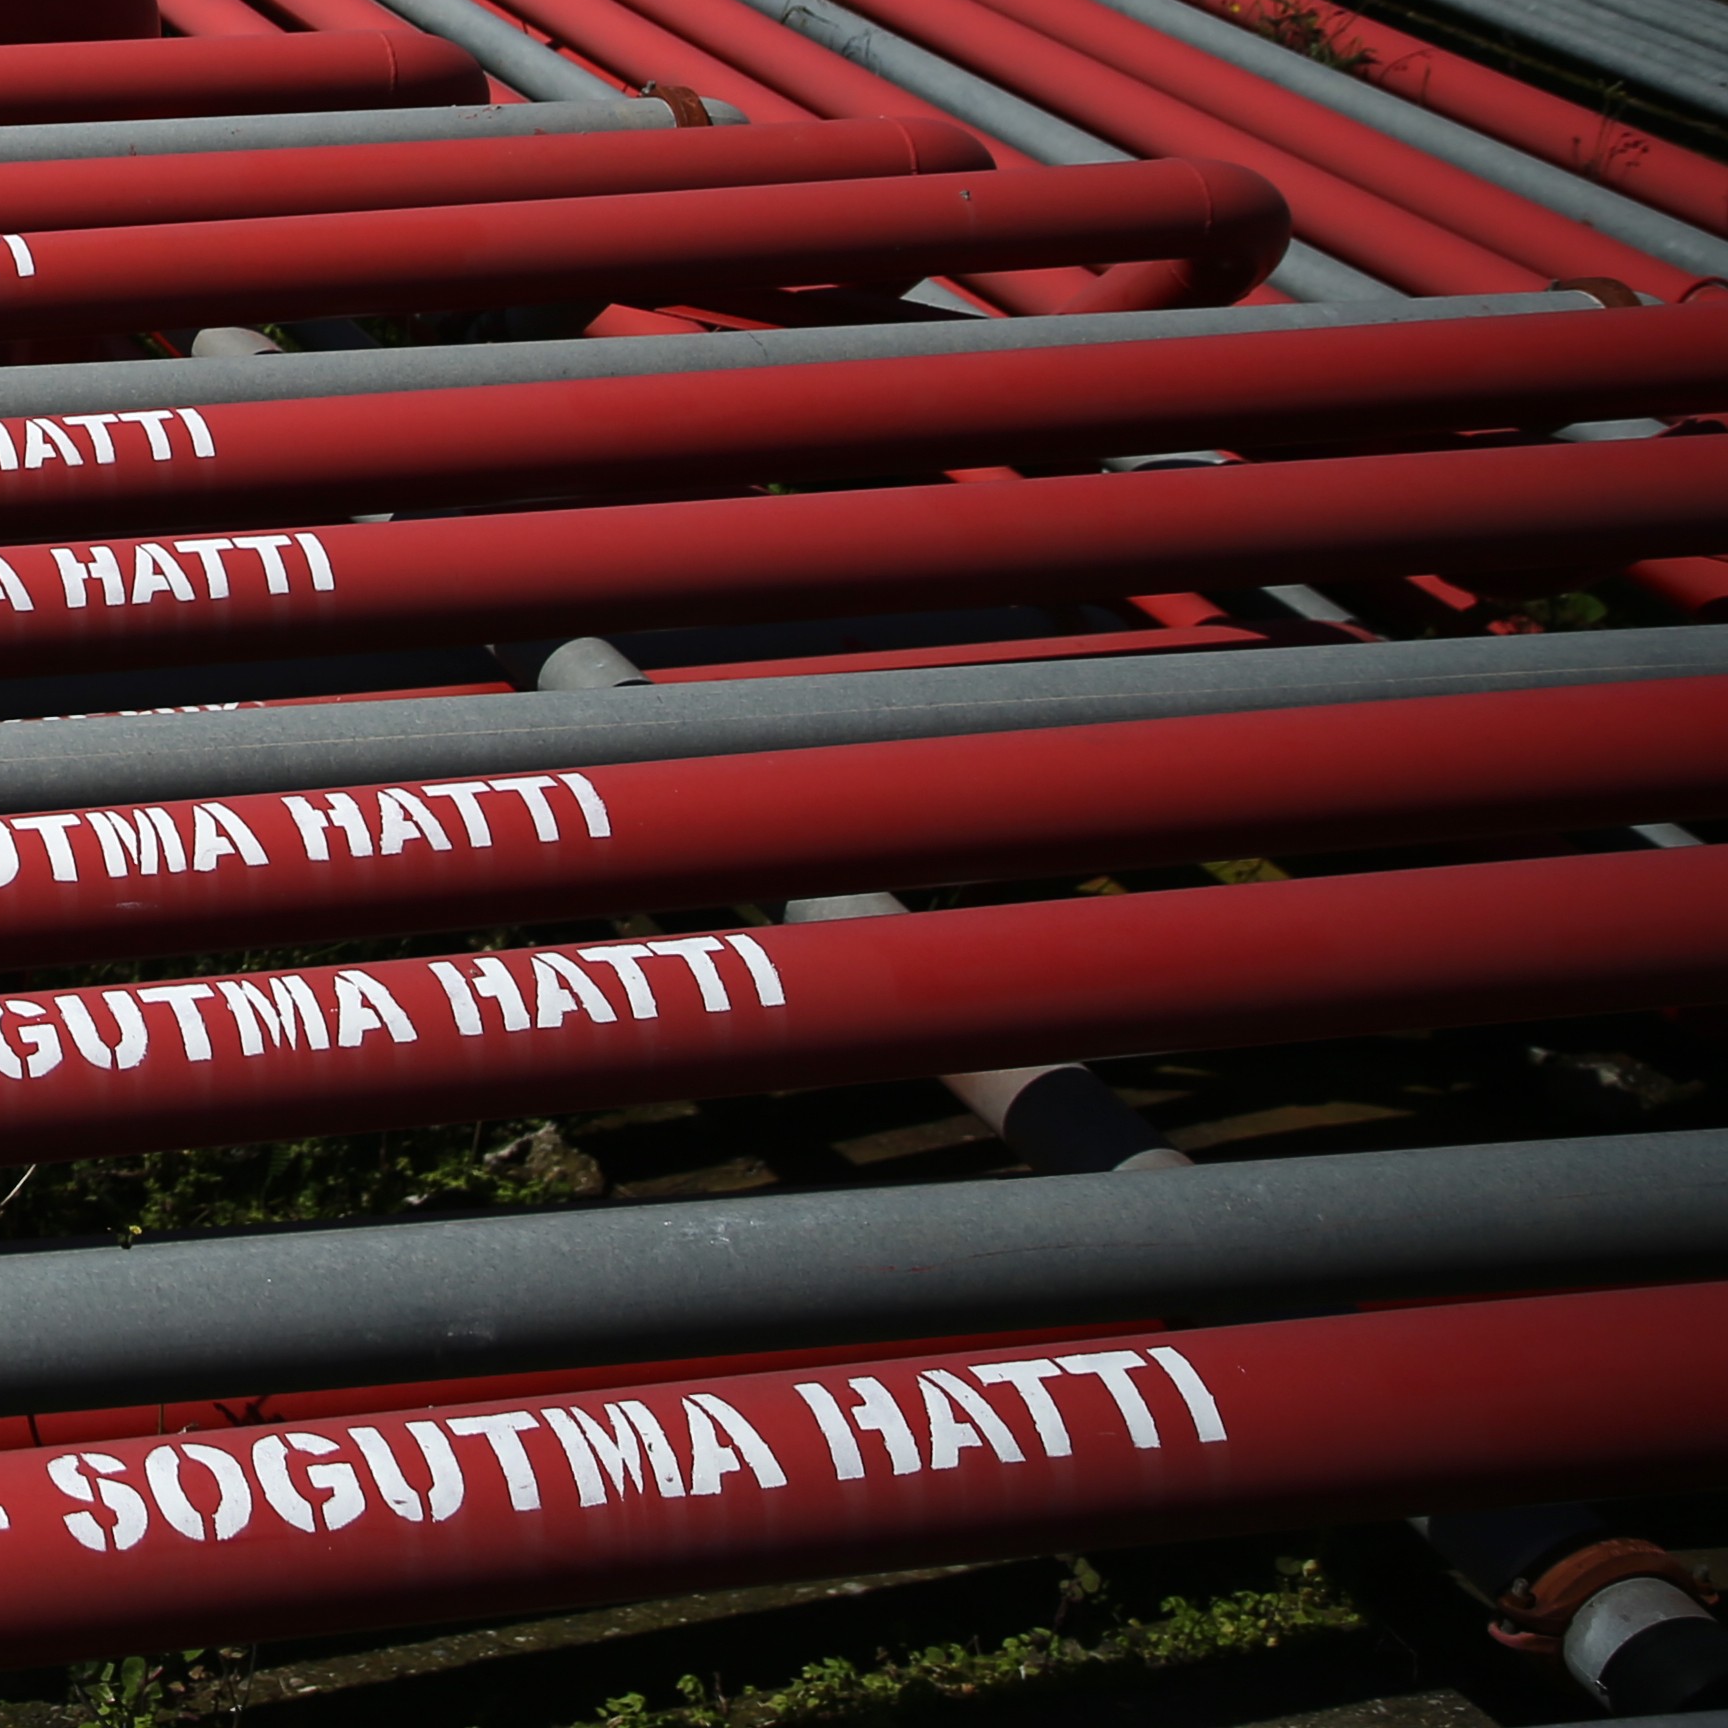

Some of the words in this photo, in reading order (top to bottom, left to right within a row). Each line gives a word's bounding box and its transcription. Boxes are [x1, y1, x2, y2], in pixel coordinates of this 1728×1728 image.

[50, 532, 335, 608] HATTI
[280, 772, 611, 861] HATTI
[427, 933, 786, 1036] HATTI
[47, 1393, 787, 1552] SOGUTMA
[793, 1346, 1227, 1481] HATTI
